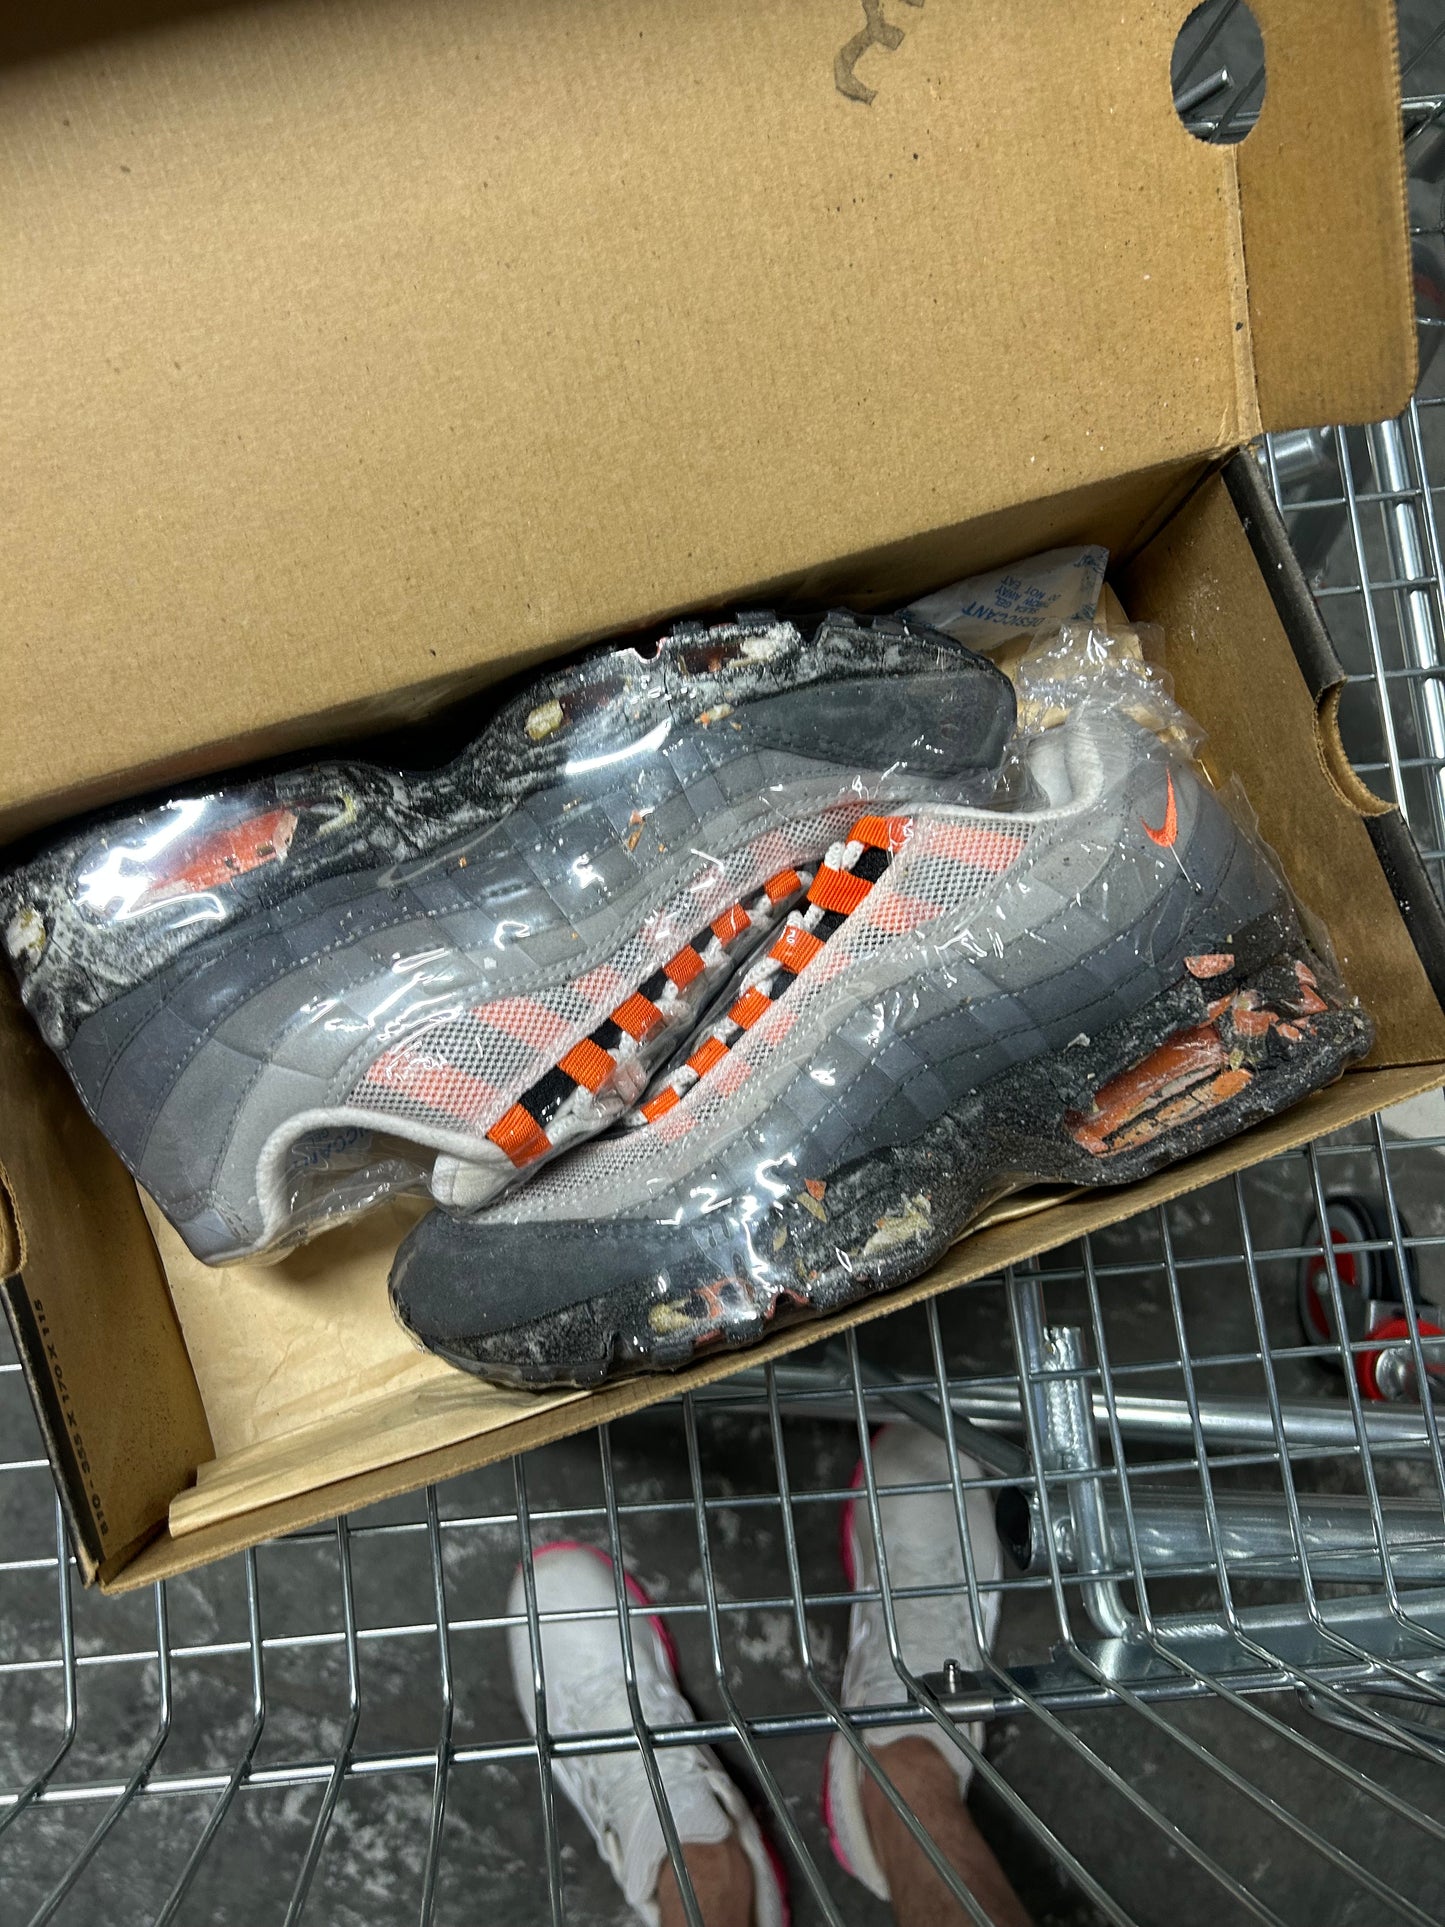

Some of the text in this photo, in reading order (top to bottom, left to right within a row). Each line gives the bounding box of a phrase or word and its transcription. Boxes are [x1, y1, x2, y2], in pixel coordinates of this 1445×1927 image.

[1000, 575, 1021, 590] EAT
[995, 587, 1021, 601] AWAY
[1024, 586, 1046, 599] NOT
[994, 595, 1012, 609] GEL
[961, 601, 1045, 627] DESICCANT
[33, 1298, 50, 1337] 115
[46, 1343, 58, 1360] X
[54, 1364, 70, 1403] 170
[66, 1409, 78, 1427] X
[73, 1432, 91, 1474] 355
